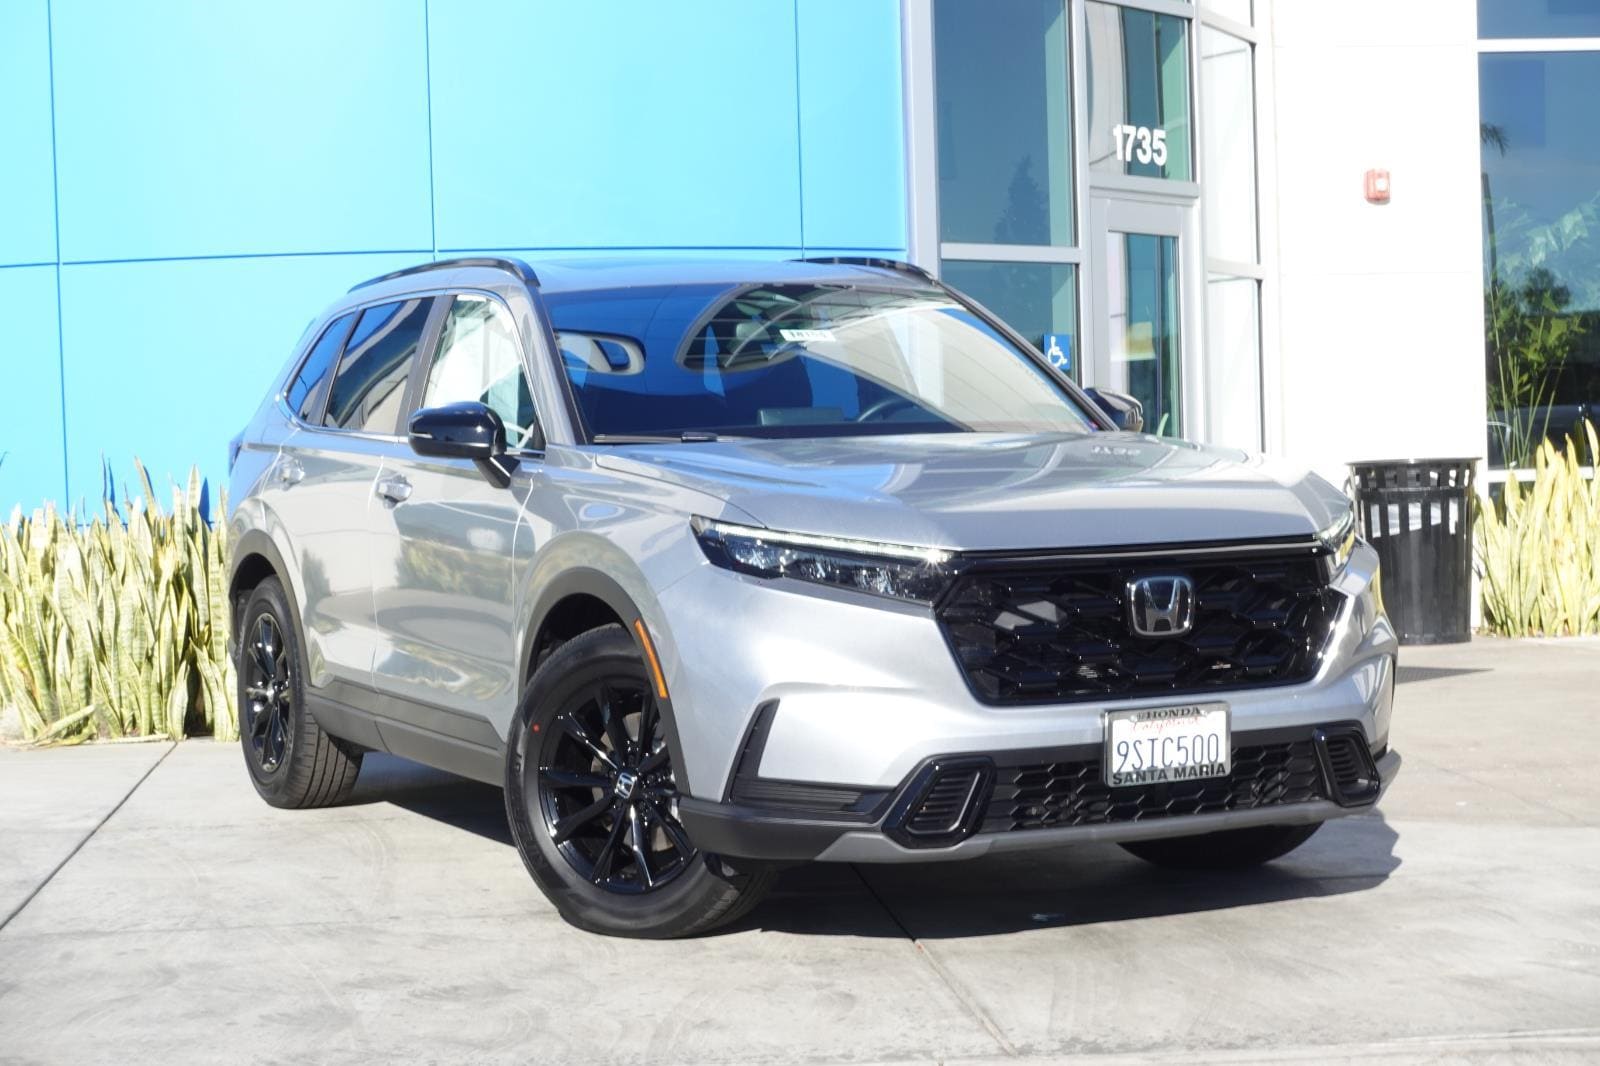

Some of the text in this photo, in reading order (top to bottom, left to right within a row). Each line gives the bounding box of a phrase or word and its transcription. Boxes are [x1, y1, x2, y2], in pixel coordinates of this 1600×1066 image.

[1112, 124, 1167, 167] 1735
[1146, 707, 1201, 720] HONDA
[1117, 733, 1219, 772] 9SIC500
[1113, 763, 1226, 785] SANTA MARIA
